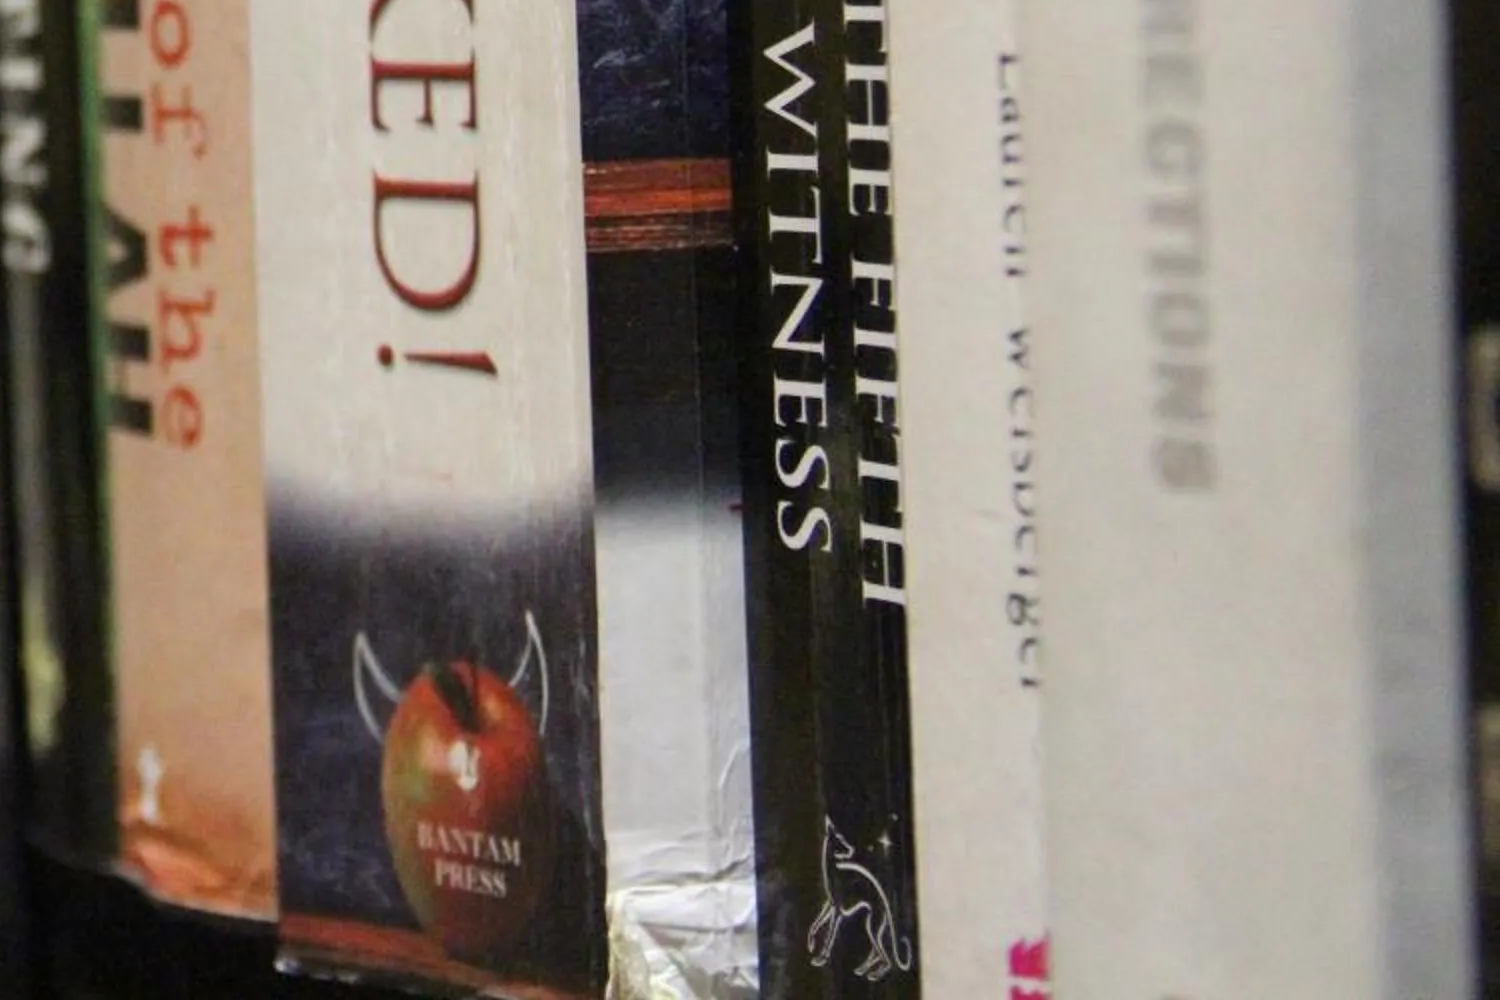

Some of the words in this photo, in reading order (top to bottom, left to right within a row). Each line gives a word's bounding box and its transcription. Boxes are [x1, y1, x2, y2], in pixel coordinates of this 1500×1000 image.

[149, 0, 207, 162] of
[154, 206, 215, 450] the
[763, 17, 833, 555] WITNESS
[851, 259, 906, 609] FIFTH
[417, 820, 520, 867] BANTAM
[434, 857, 506, 898] PRESS
